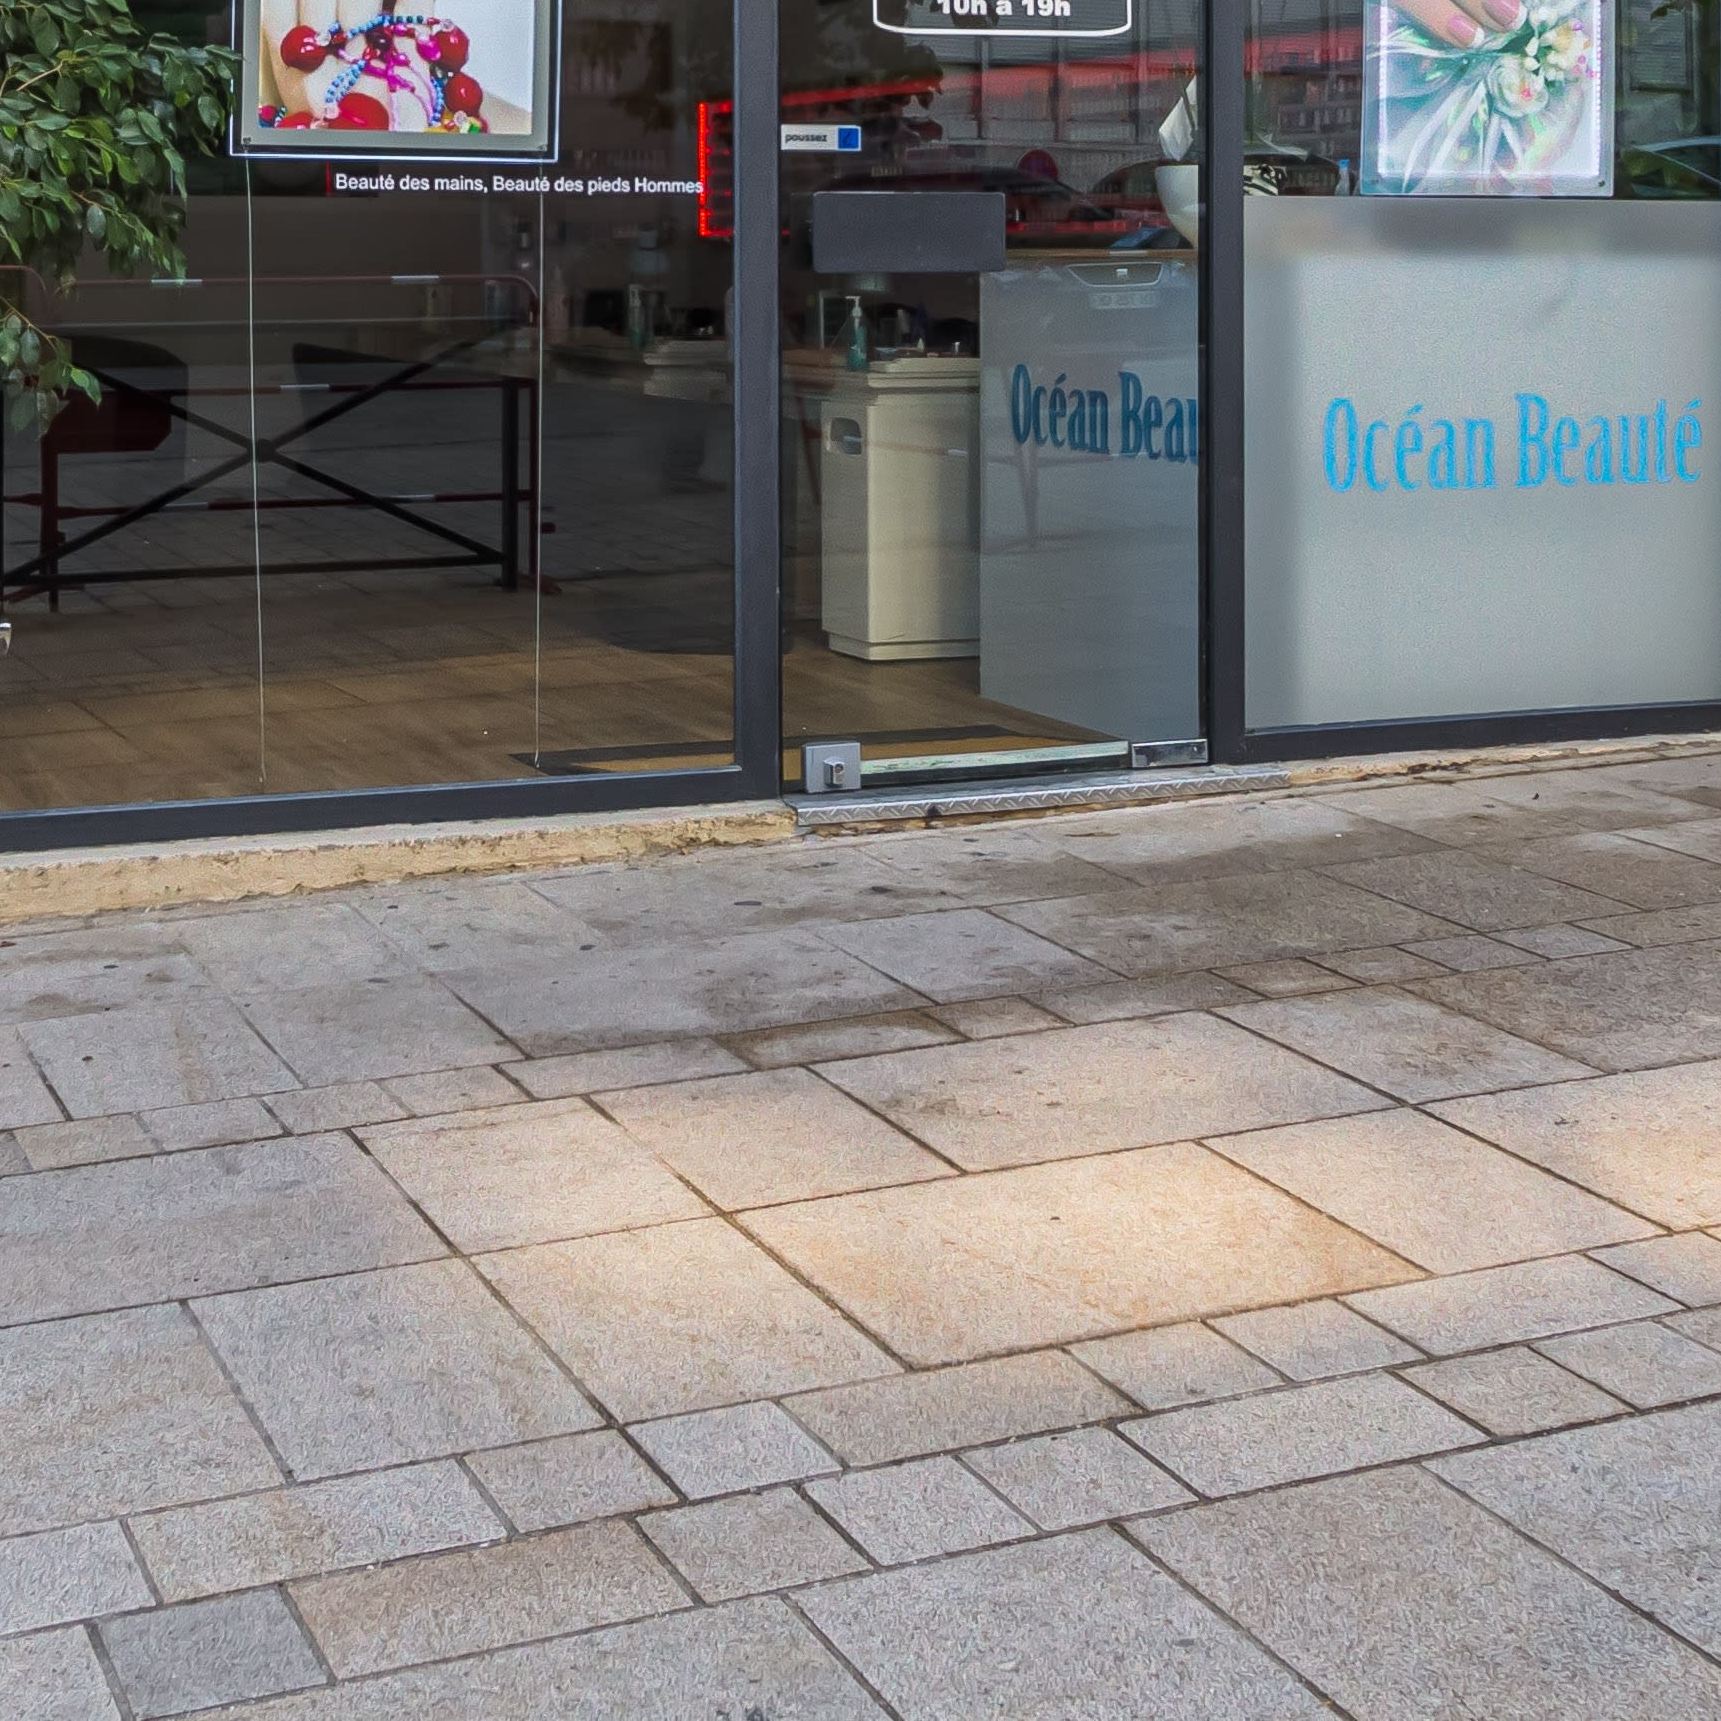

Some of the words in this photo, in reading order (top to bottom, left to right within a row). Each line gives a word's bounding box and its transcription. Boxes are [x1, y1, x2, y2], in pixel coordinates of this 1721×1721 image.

[335, 173, 395, 191] Beauté
[399, 174, 430, 191] des
[434, 174, 488, 194] mains,
[492, 175, 551, 192] Beauté
[553, 176, 584, 193] des
[587, 176, 631, 196] pieds
[634, 177, 705, 194] Hommes
[1010, 363, 1110, 455] Océan
[1322, 397, 1498, 493] Océan
[1514, 392, 1703, 489] Beauté
